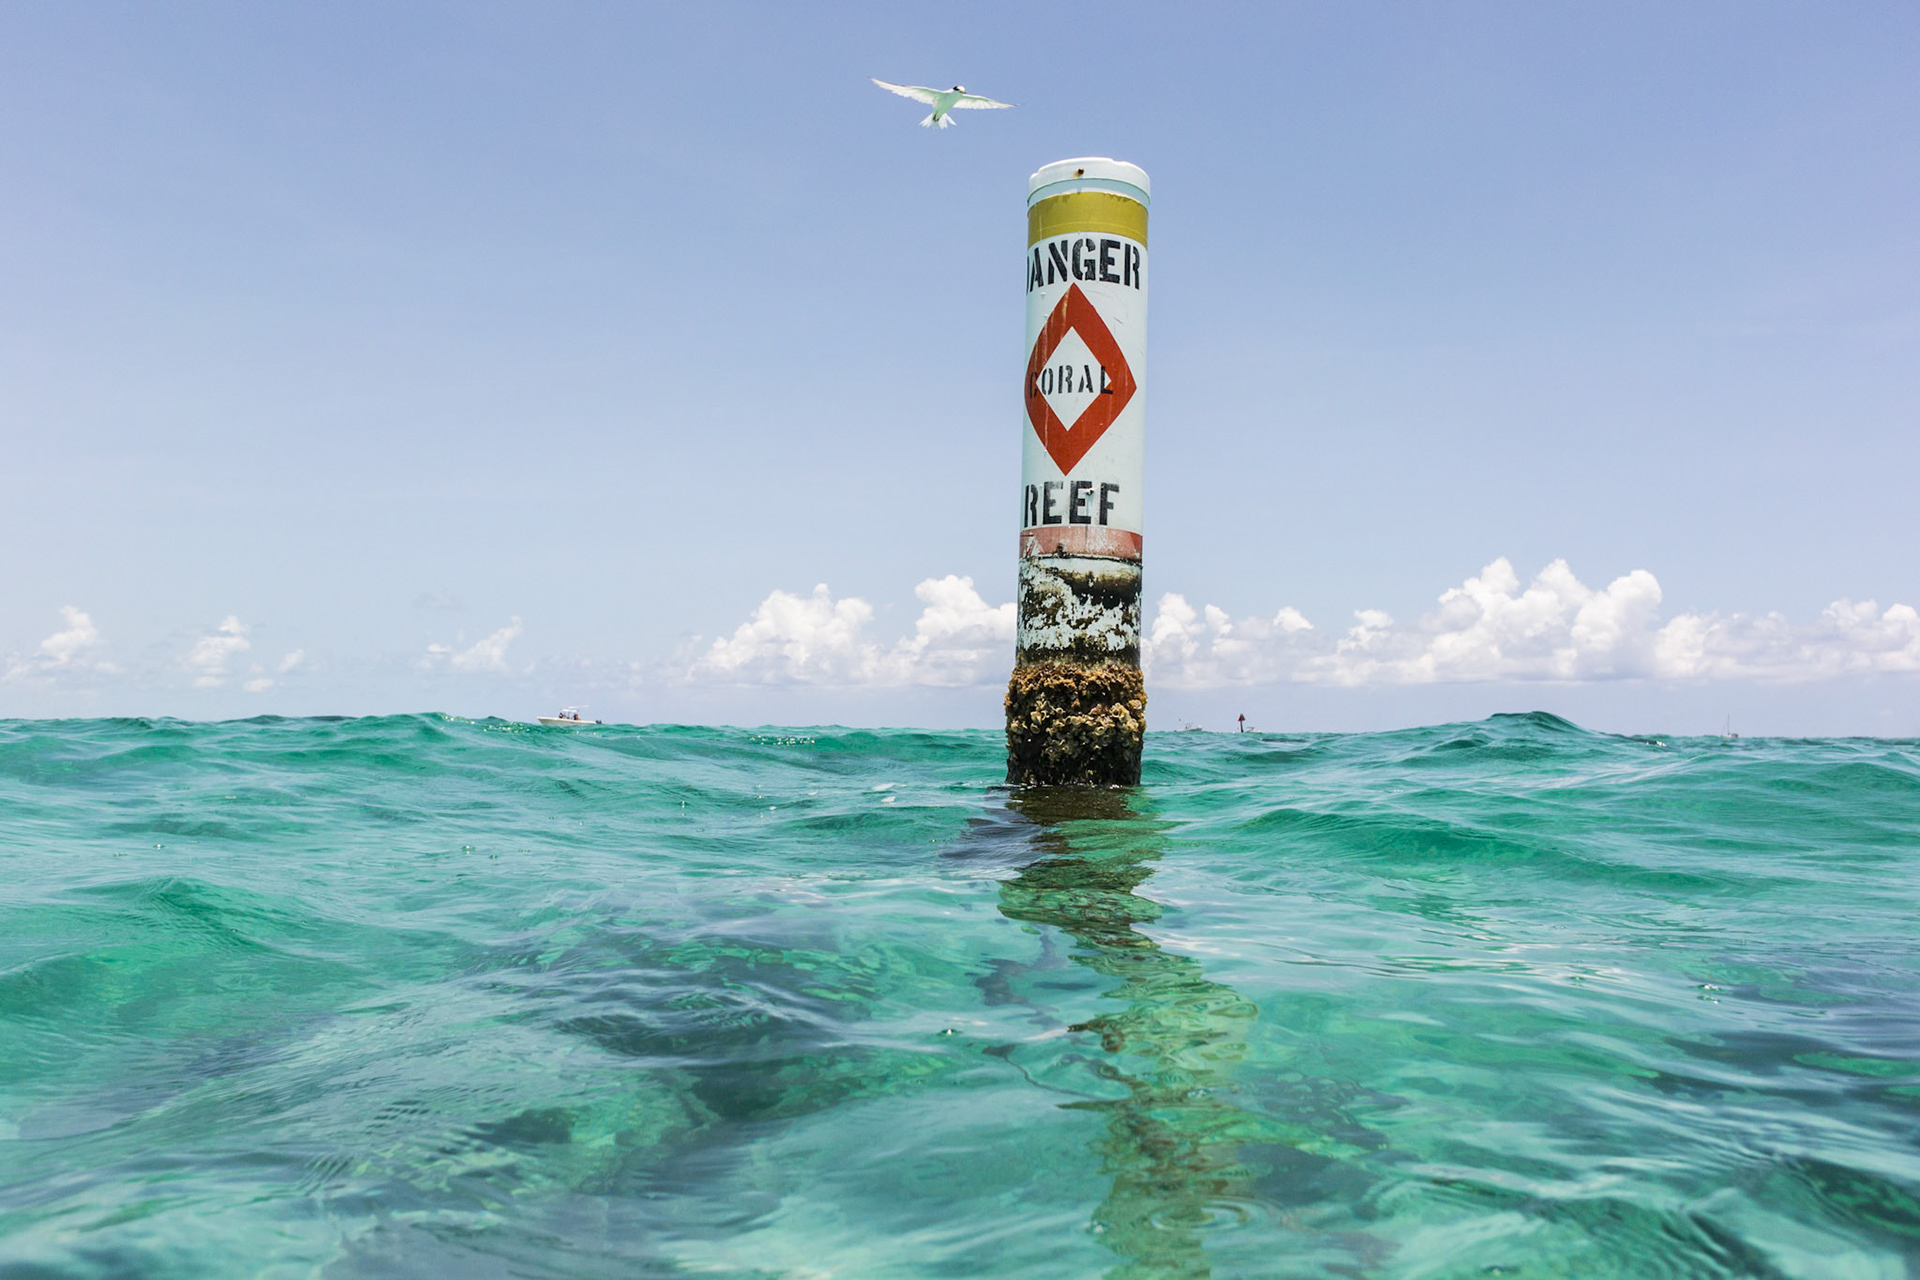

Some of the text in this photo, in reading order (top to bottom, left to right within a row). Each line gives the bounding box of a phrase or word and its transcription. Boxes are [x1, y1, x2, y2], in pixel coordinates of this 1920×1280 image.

[1027, 238, 1140, 294] ANGER
[1029, 364, 1113, 398] CORAL
[1024, 480, 1120, 528] REEF
